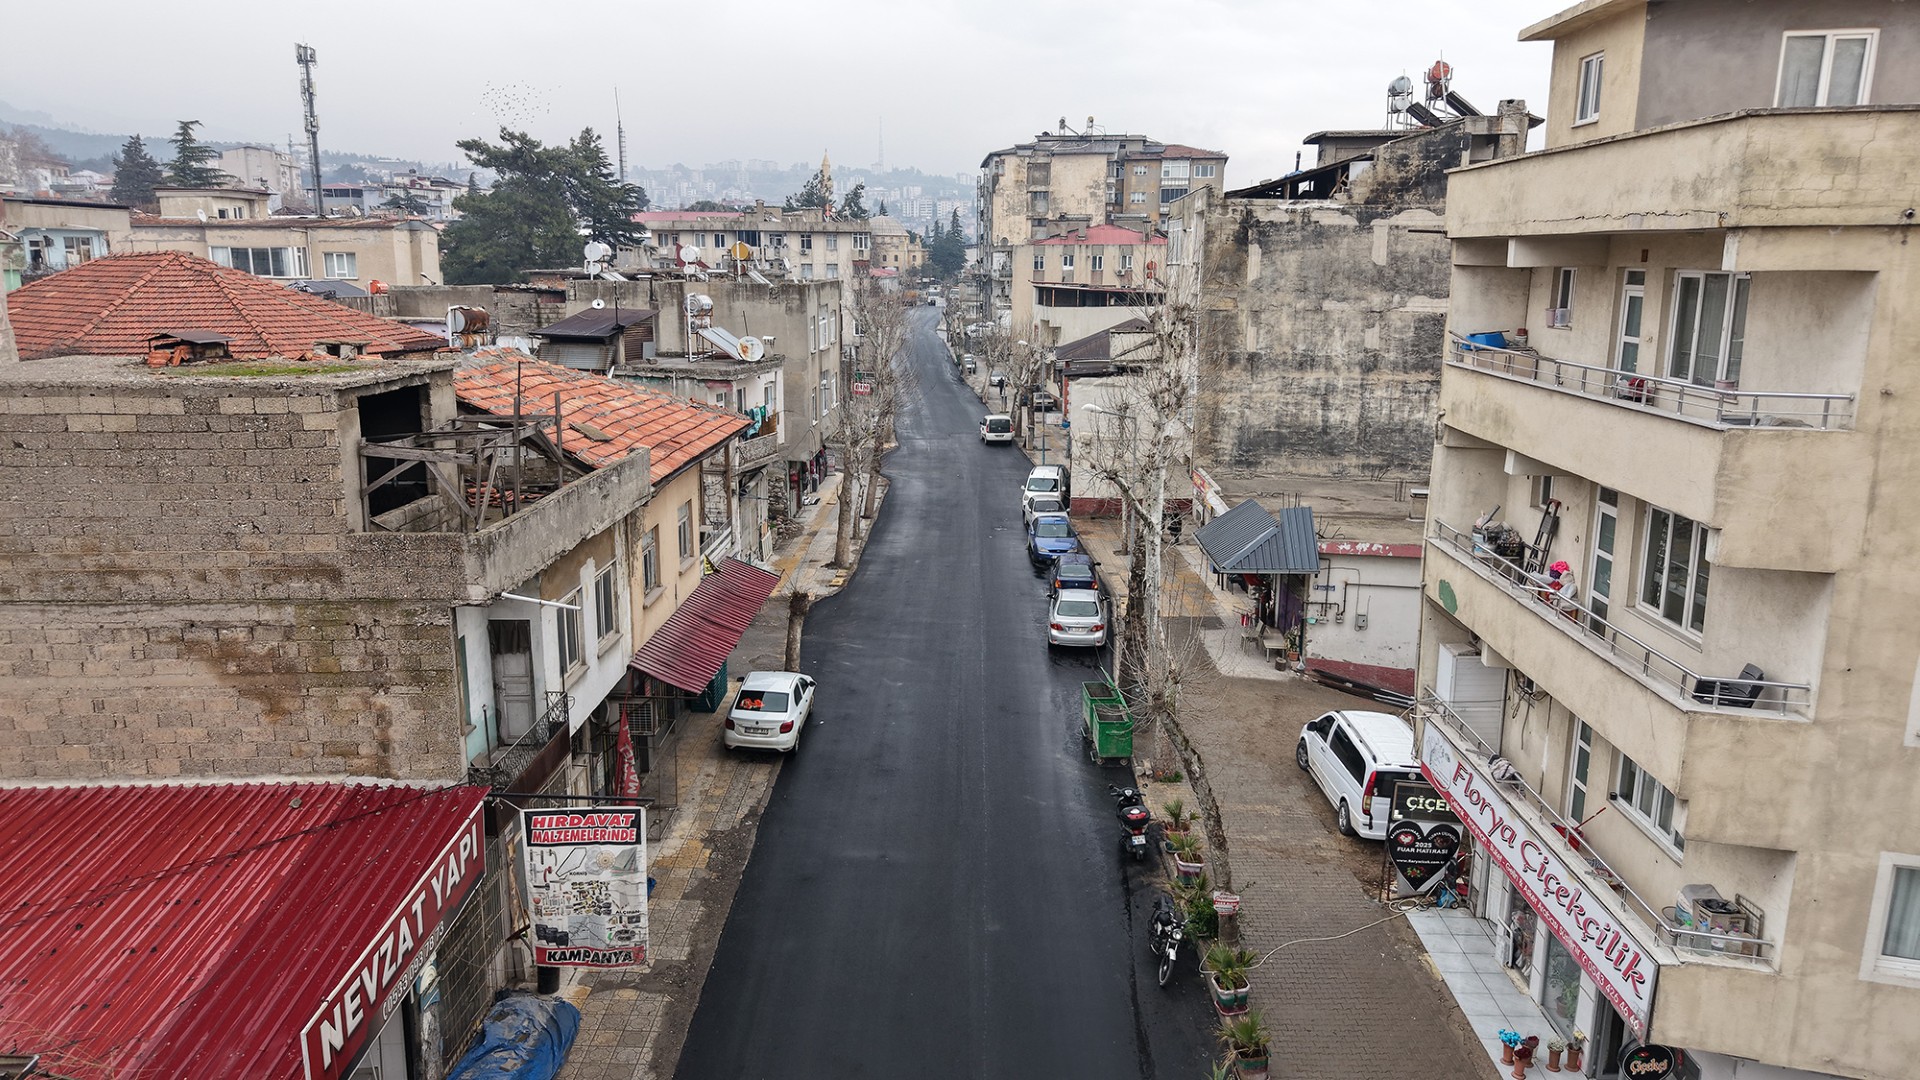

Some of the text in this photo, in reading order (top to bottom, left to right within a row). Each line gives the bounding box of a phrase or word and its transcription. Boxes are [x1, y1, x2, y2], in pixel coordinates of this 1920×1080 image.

[531, 813, 635, 829] HIRDAVAT
[531, 828, 637, 844] MALZEMELERİNDE
[1452, 761, 1645, 1000] Florya Çiçekçilik
[319, 823, 478, 1071] NEVZAT YAPI
[546, 949, 634, 964] KAMPANYA
[1588, 961, 1605, 986] 0543
[1605, 985, 1619, 1003] 426
[1619, 1002, 1629, 1016] 46
[1629, 1015, 1639, 1030] 46
